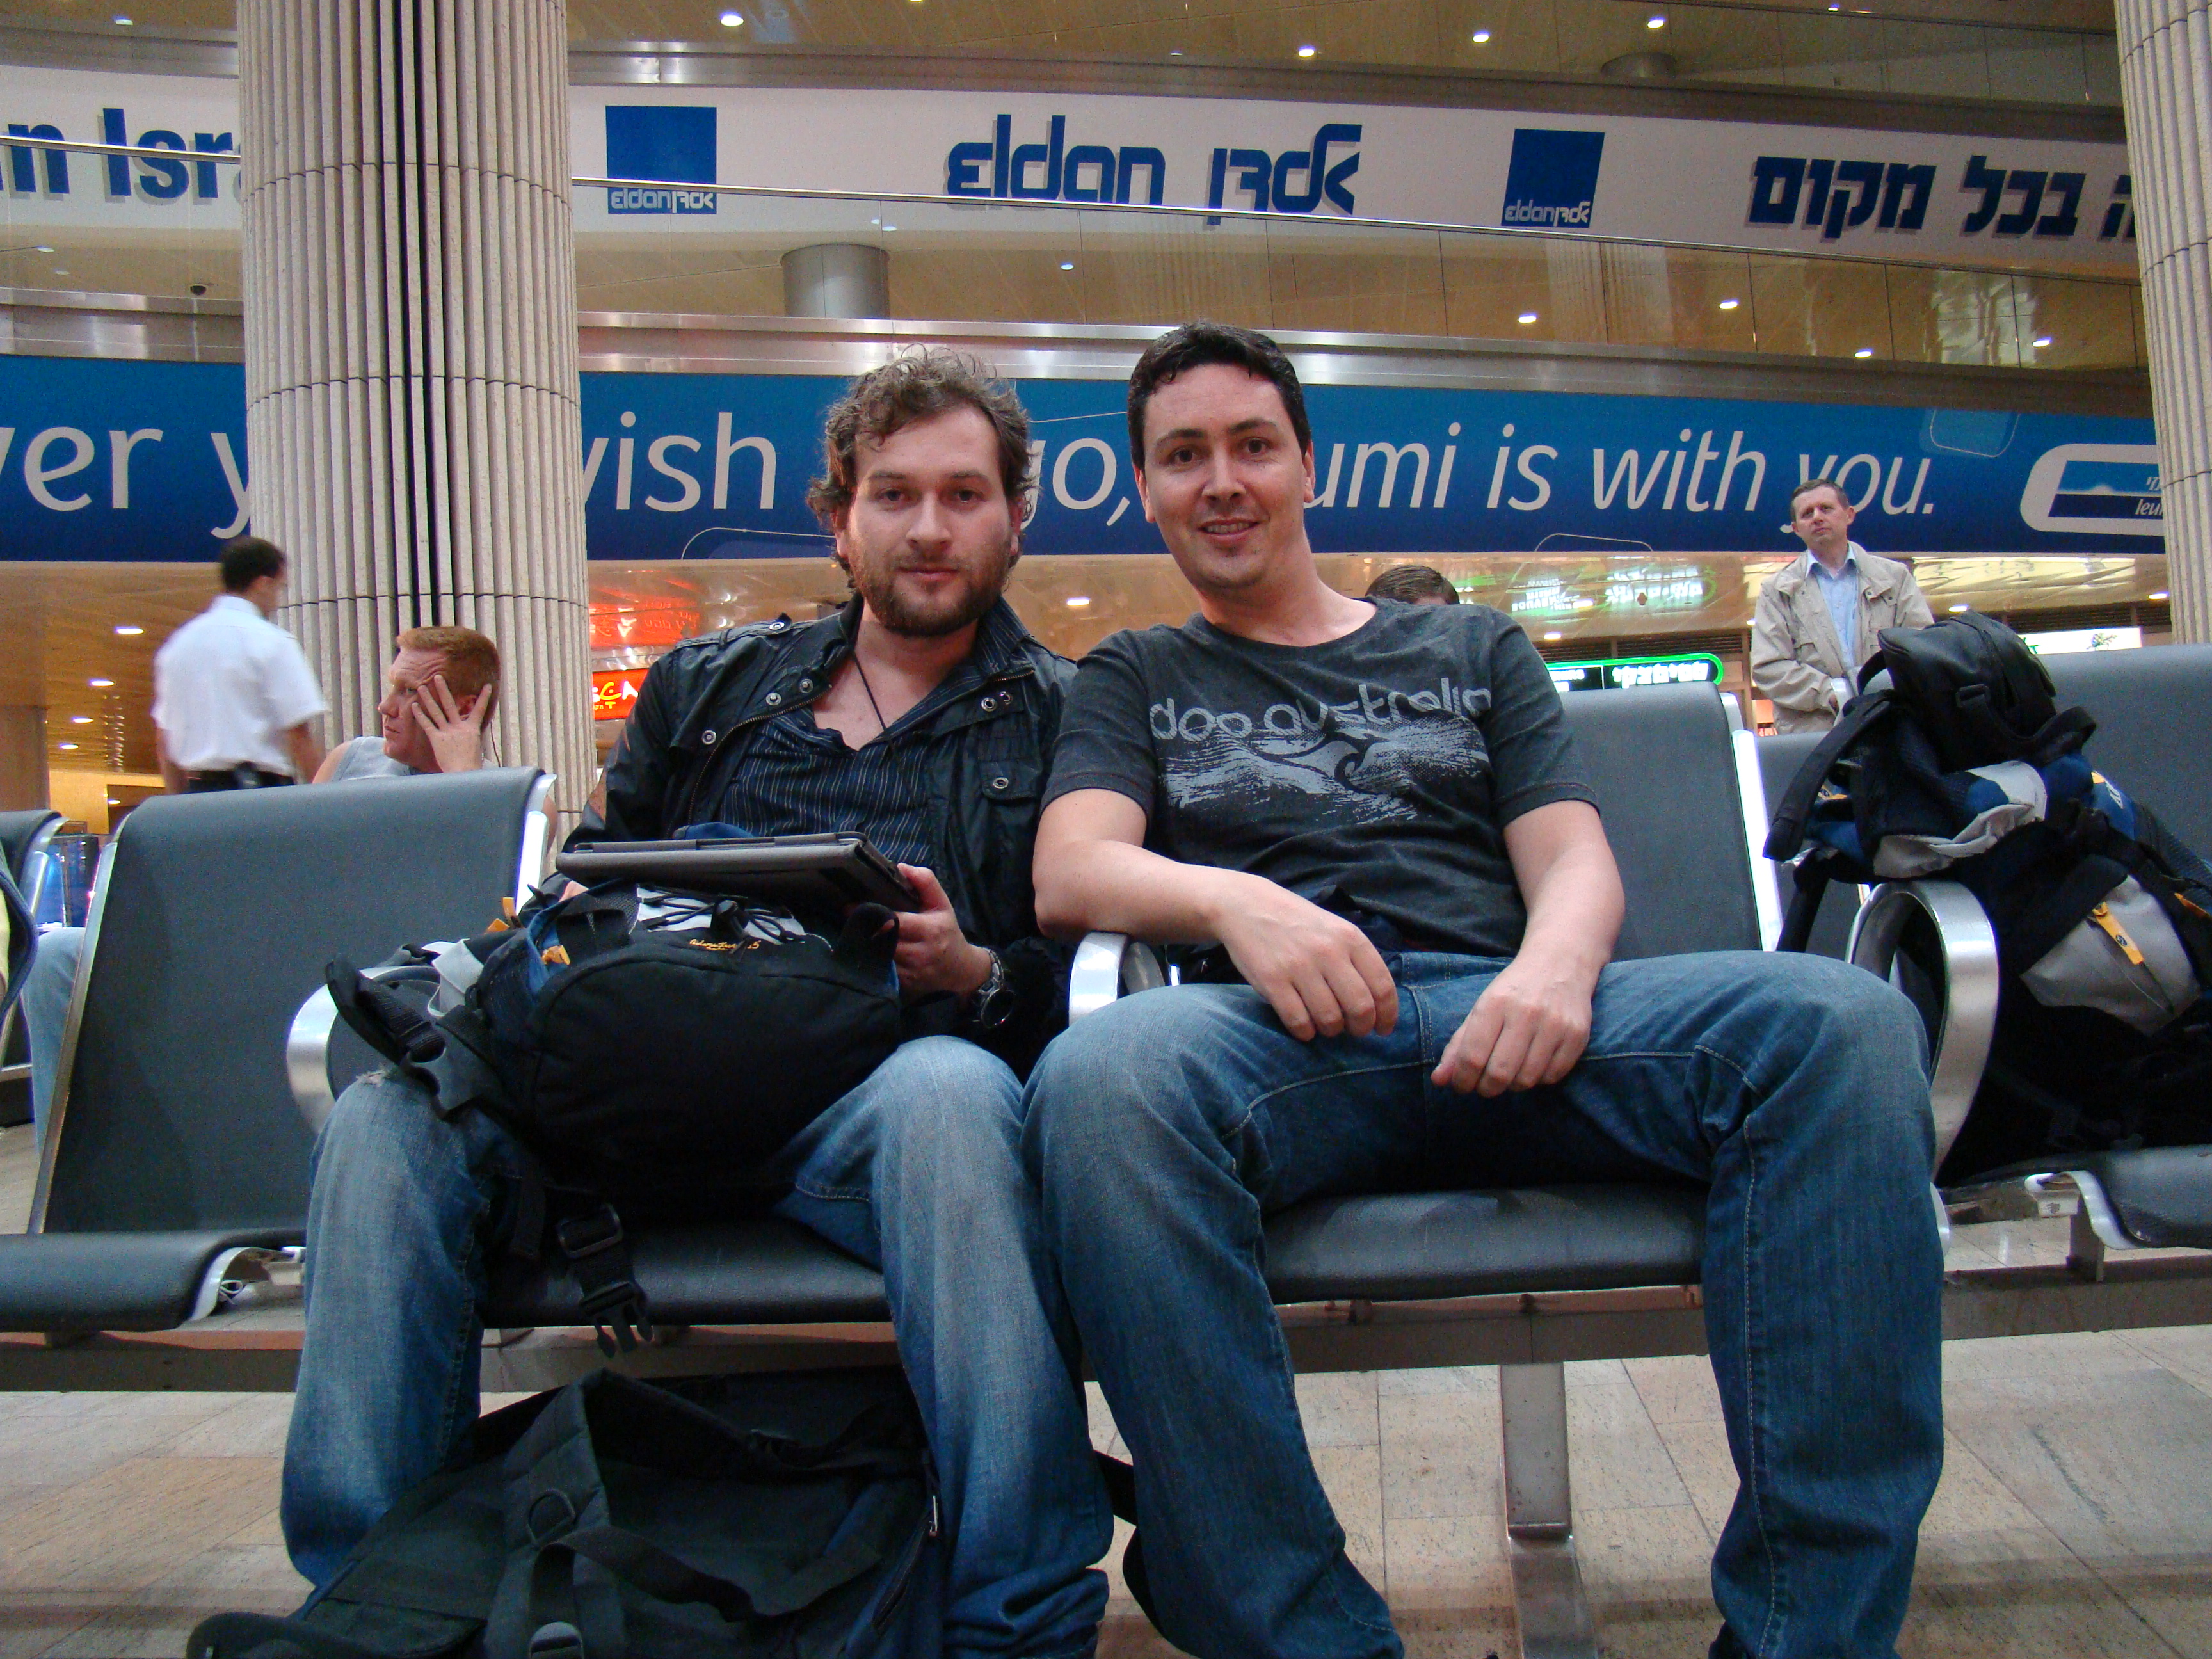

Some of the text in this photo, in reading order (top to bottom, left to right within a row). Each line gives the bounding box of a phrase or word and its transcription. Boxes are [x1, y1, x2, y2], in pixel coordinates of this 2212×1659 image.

[103, 108, 241, 199] Isr
[947, 114, 1166, 205] eldan
[611, 188, 671, 209] eldan
[1505, 198, 1555, 223] eldan
[1748, 156, 1937, 239] מקום
[1964, 155, 2087, 236] בכל
[1304, 422, 1461, 509] umi
[1487, 423, 1558, 511] is
[1593, 428, 1767, 513] with
[2135, 498, 2163, 515] leu
[1149, 698, 1253, 742] doo
